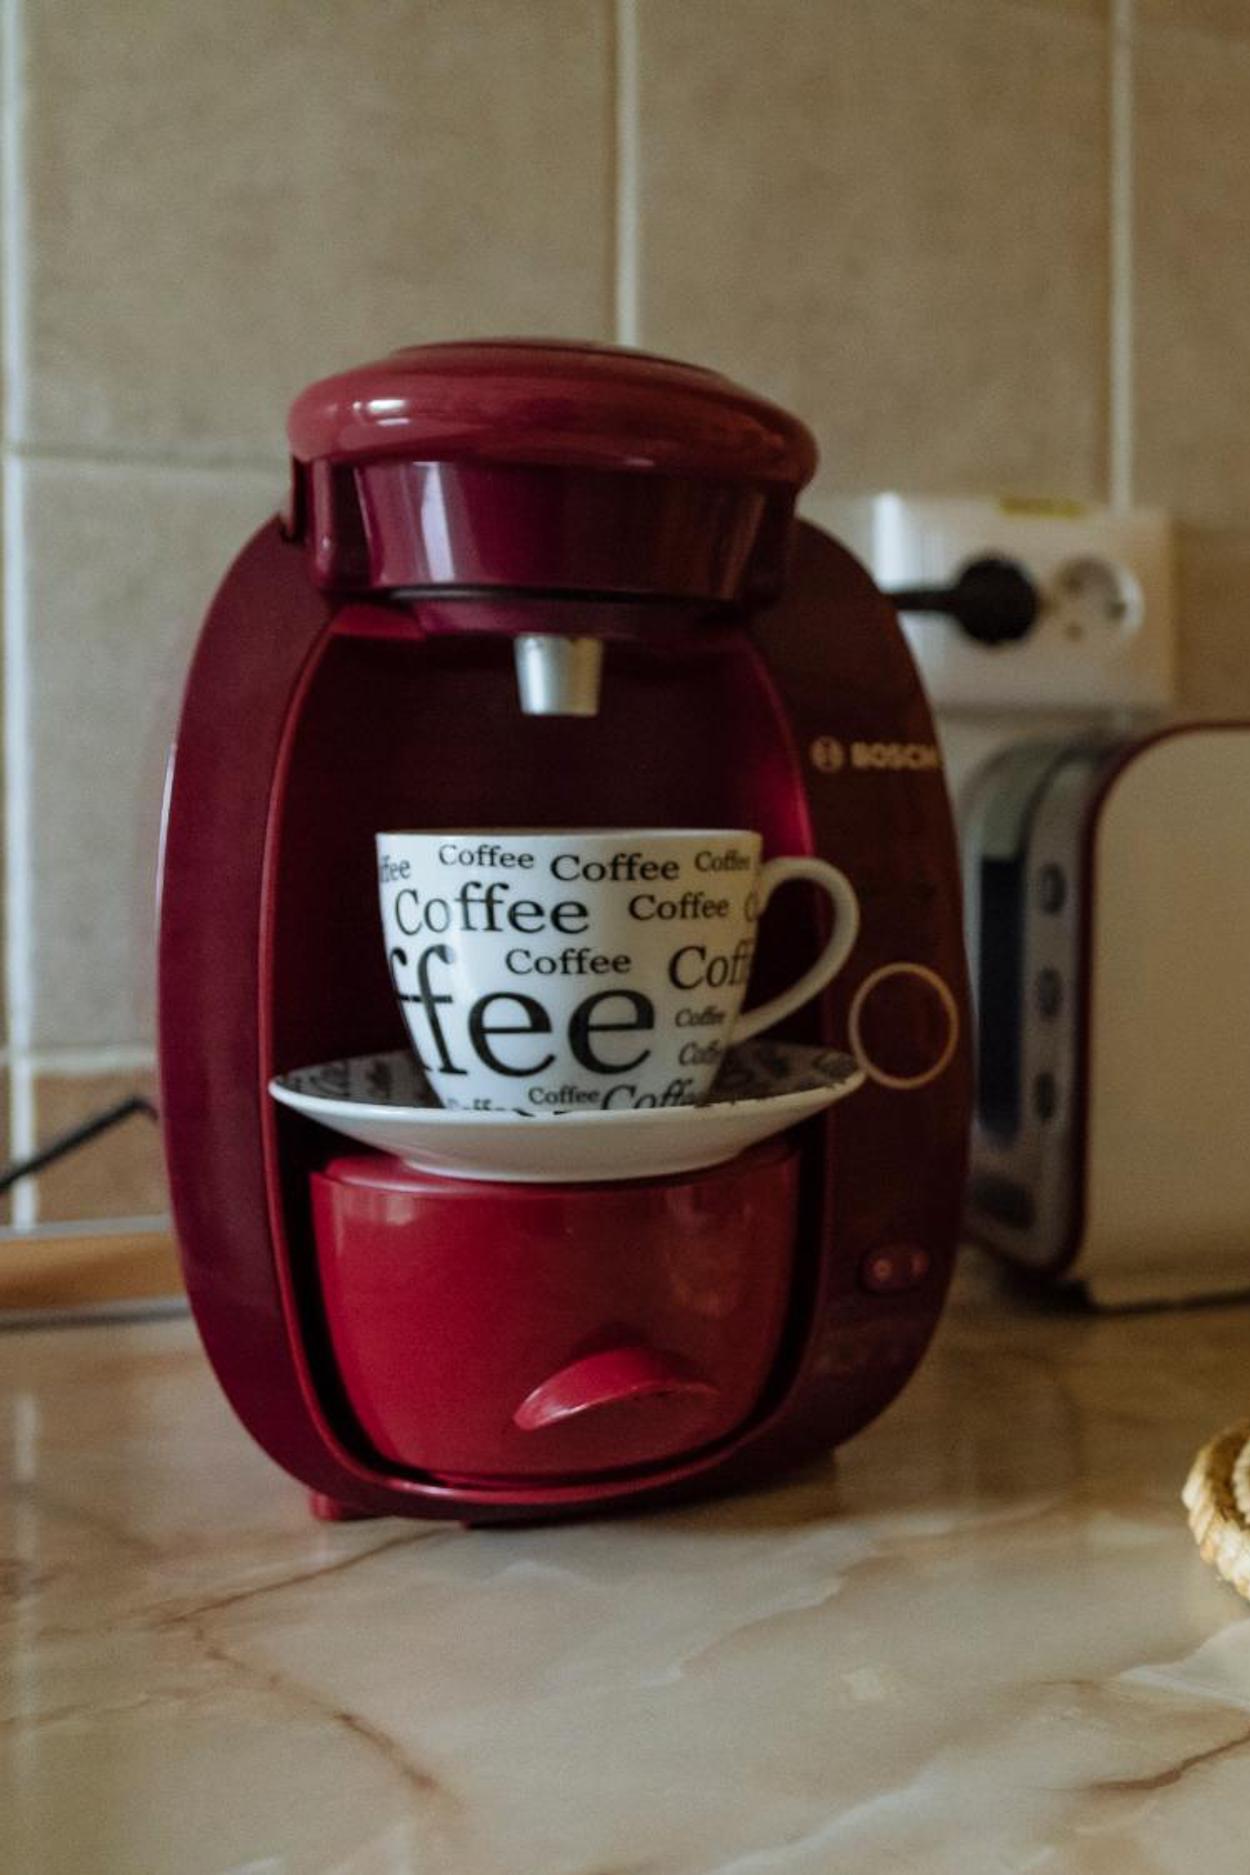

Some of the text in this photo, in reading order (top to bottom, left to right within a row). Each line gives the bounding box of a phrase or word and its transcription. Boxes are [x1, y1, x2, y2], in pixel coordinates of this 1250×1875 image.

[438, 844, 535, 870] Coffee
[550, 853, 681, 882] Coffee
[395, 881, 590, 936] Coffee
[628, 892, 730, 921] Coffee
[505, 948, 632, 975] Coffee
[528, 1086, 600, 1107] Coffee
